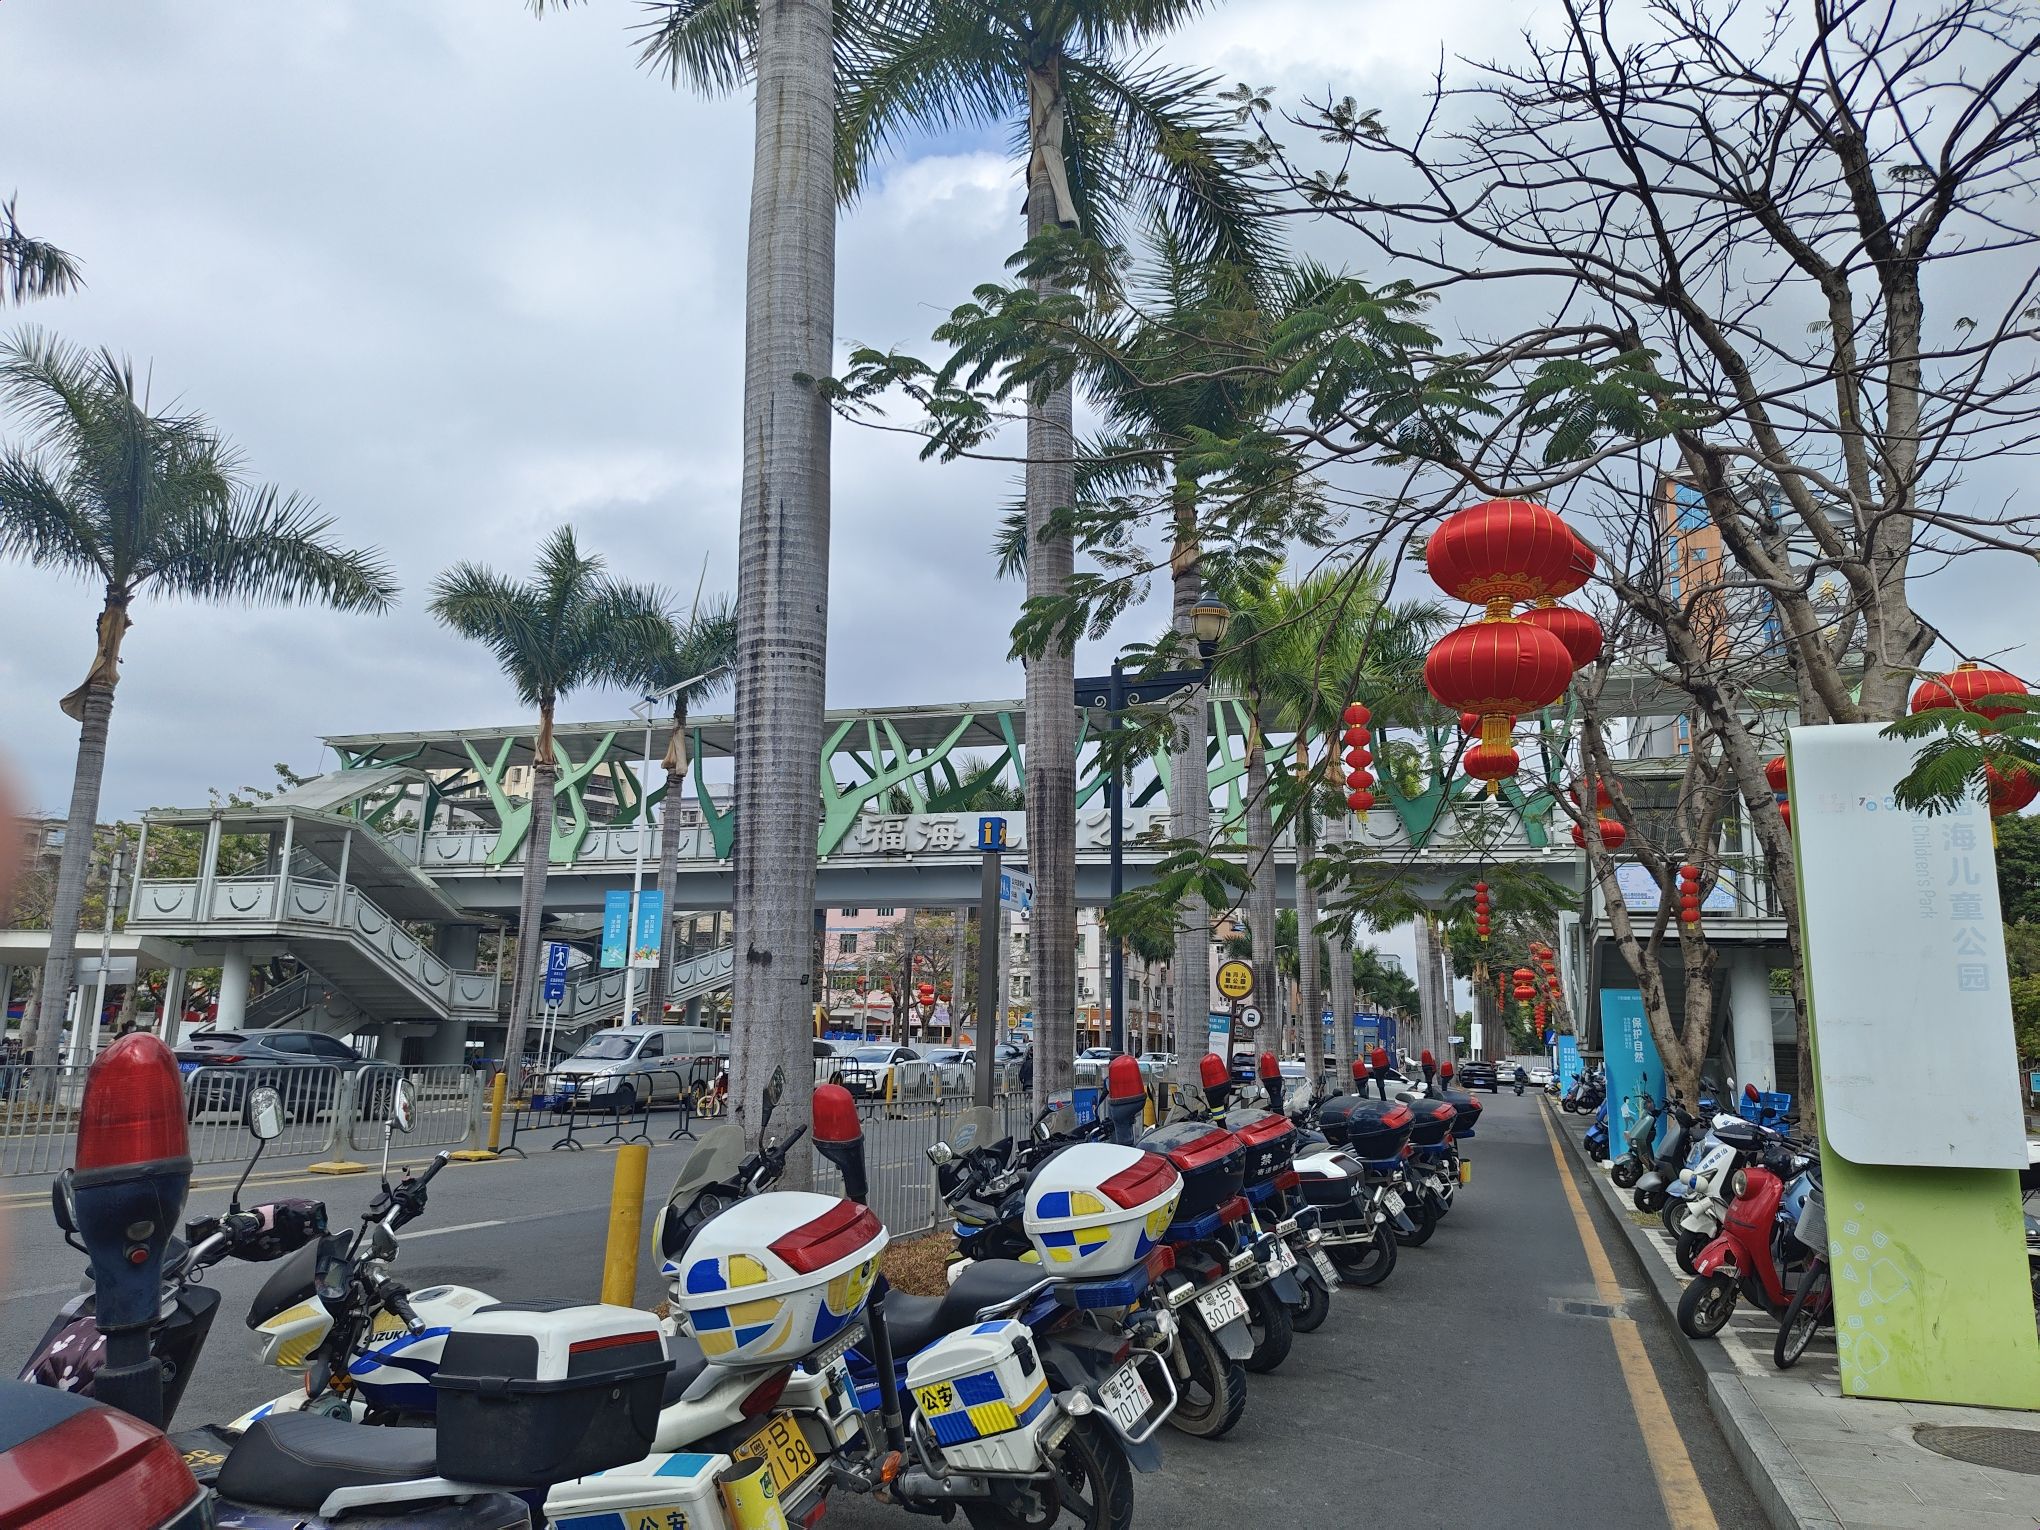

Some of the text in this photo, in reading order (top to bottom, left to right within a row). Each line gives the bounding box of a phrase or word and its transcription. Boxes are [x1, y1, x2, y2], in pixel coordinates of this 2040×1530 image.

[1913, 825, 1933, 887] Children's
[1920, 890, 1939, 919] Park
[1631, 1017, 1645, 1063] 保护自然
[1206, 1299, 1240, 1328] 3072
[363, 1330, 408, 1345] SUZUKI
[921, 1385, 953, 1411] 公安
[1112, 1389, 1145, 1430] 7077
